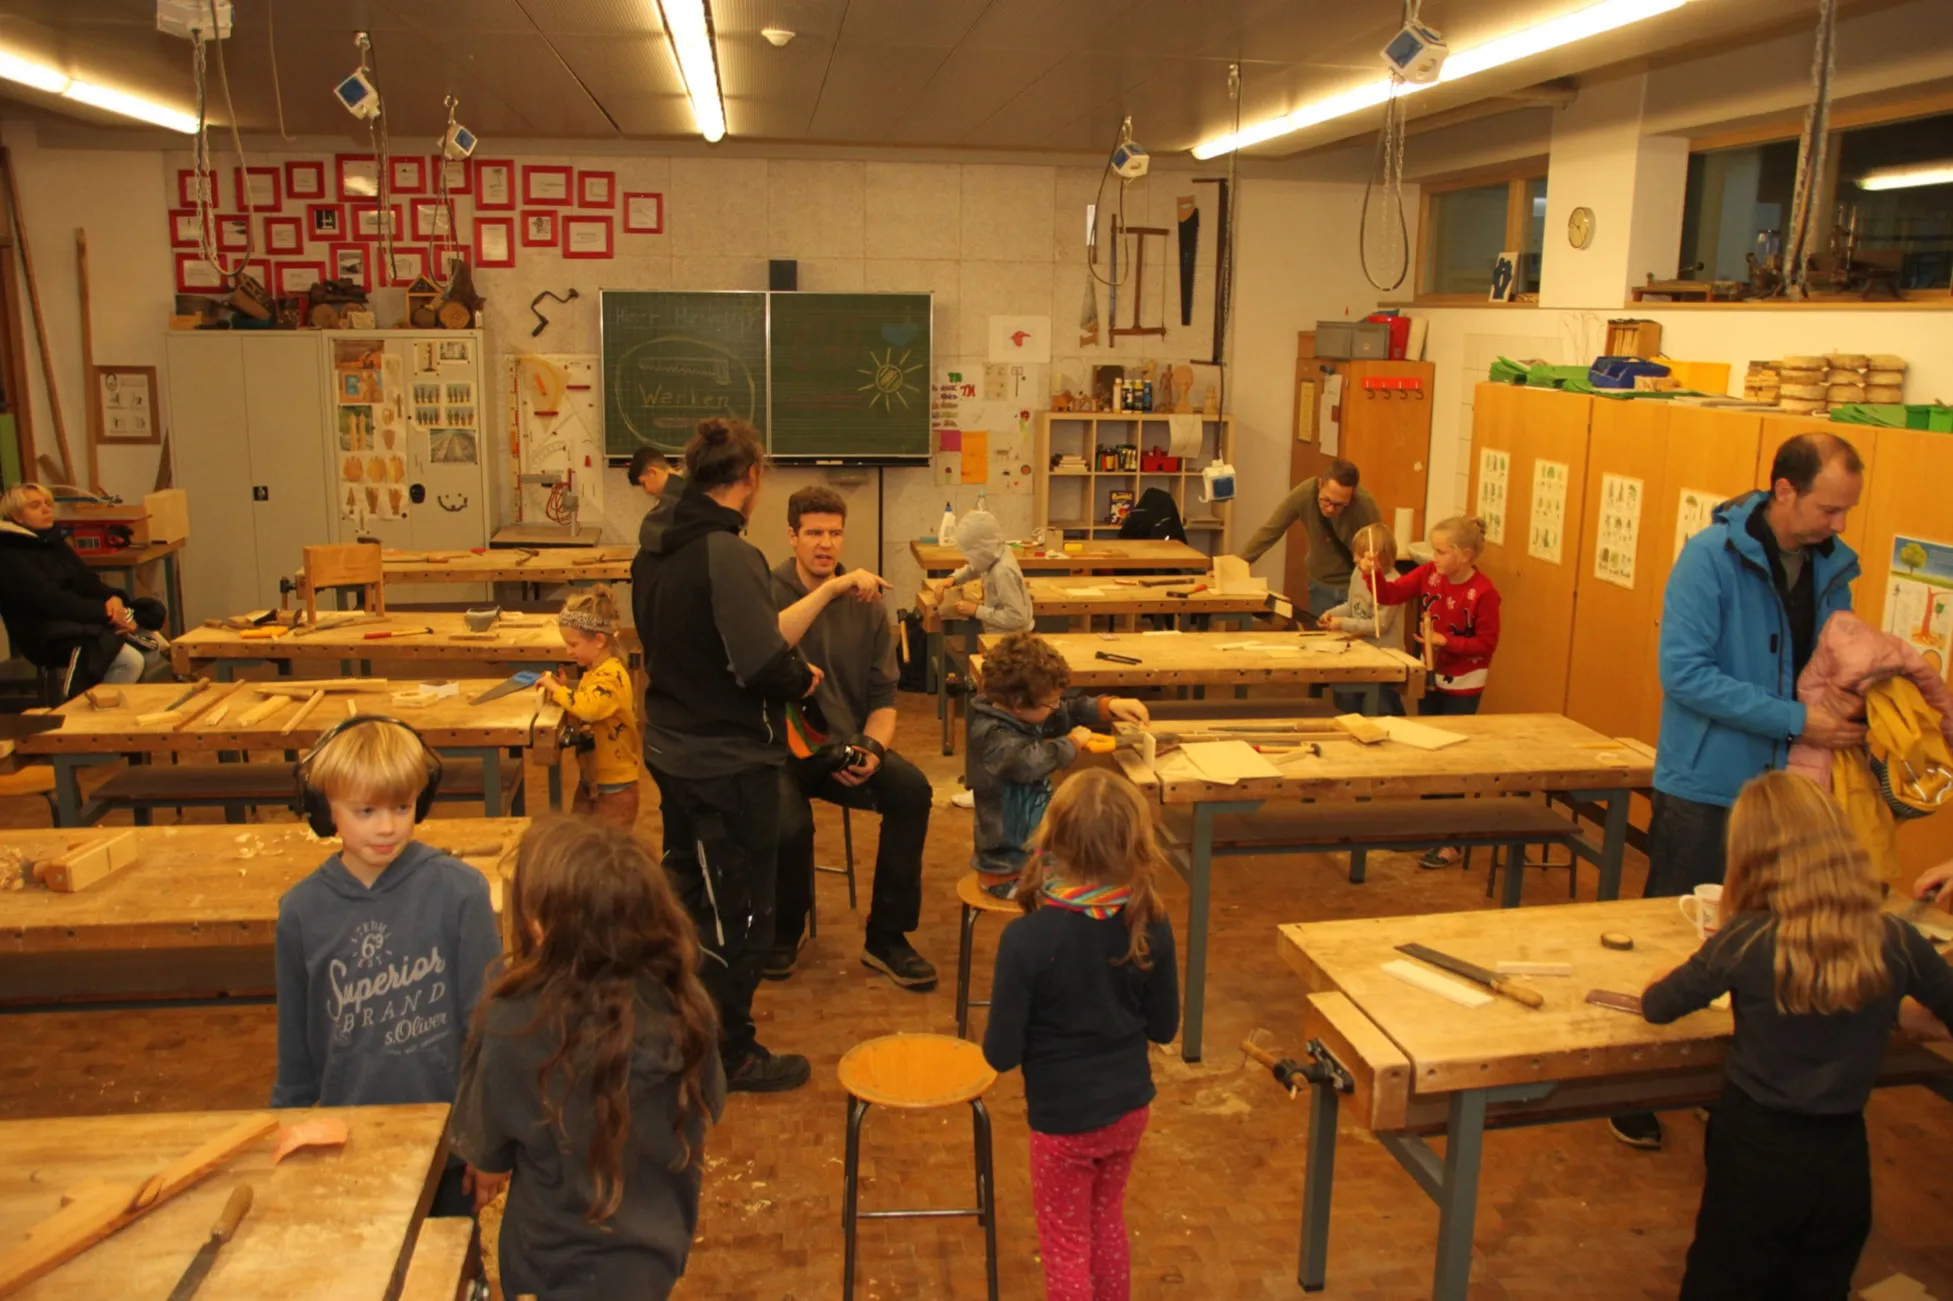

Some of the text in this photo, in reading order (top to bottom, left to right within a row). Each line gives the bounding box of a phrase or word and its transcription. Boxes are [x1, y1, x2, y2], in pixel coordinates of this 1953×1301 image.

[638, 382, 729, 406] Werken
[326, 946, 447, 1022] Superior
[342, 982, 446, 1034] BRAND
[384, 1011, 448, 1046] s.Oliver
